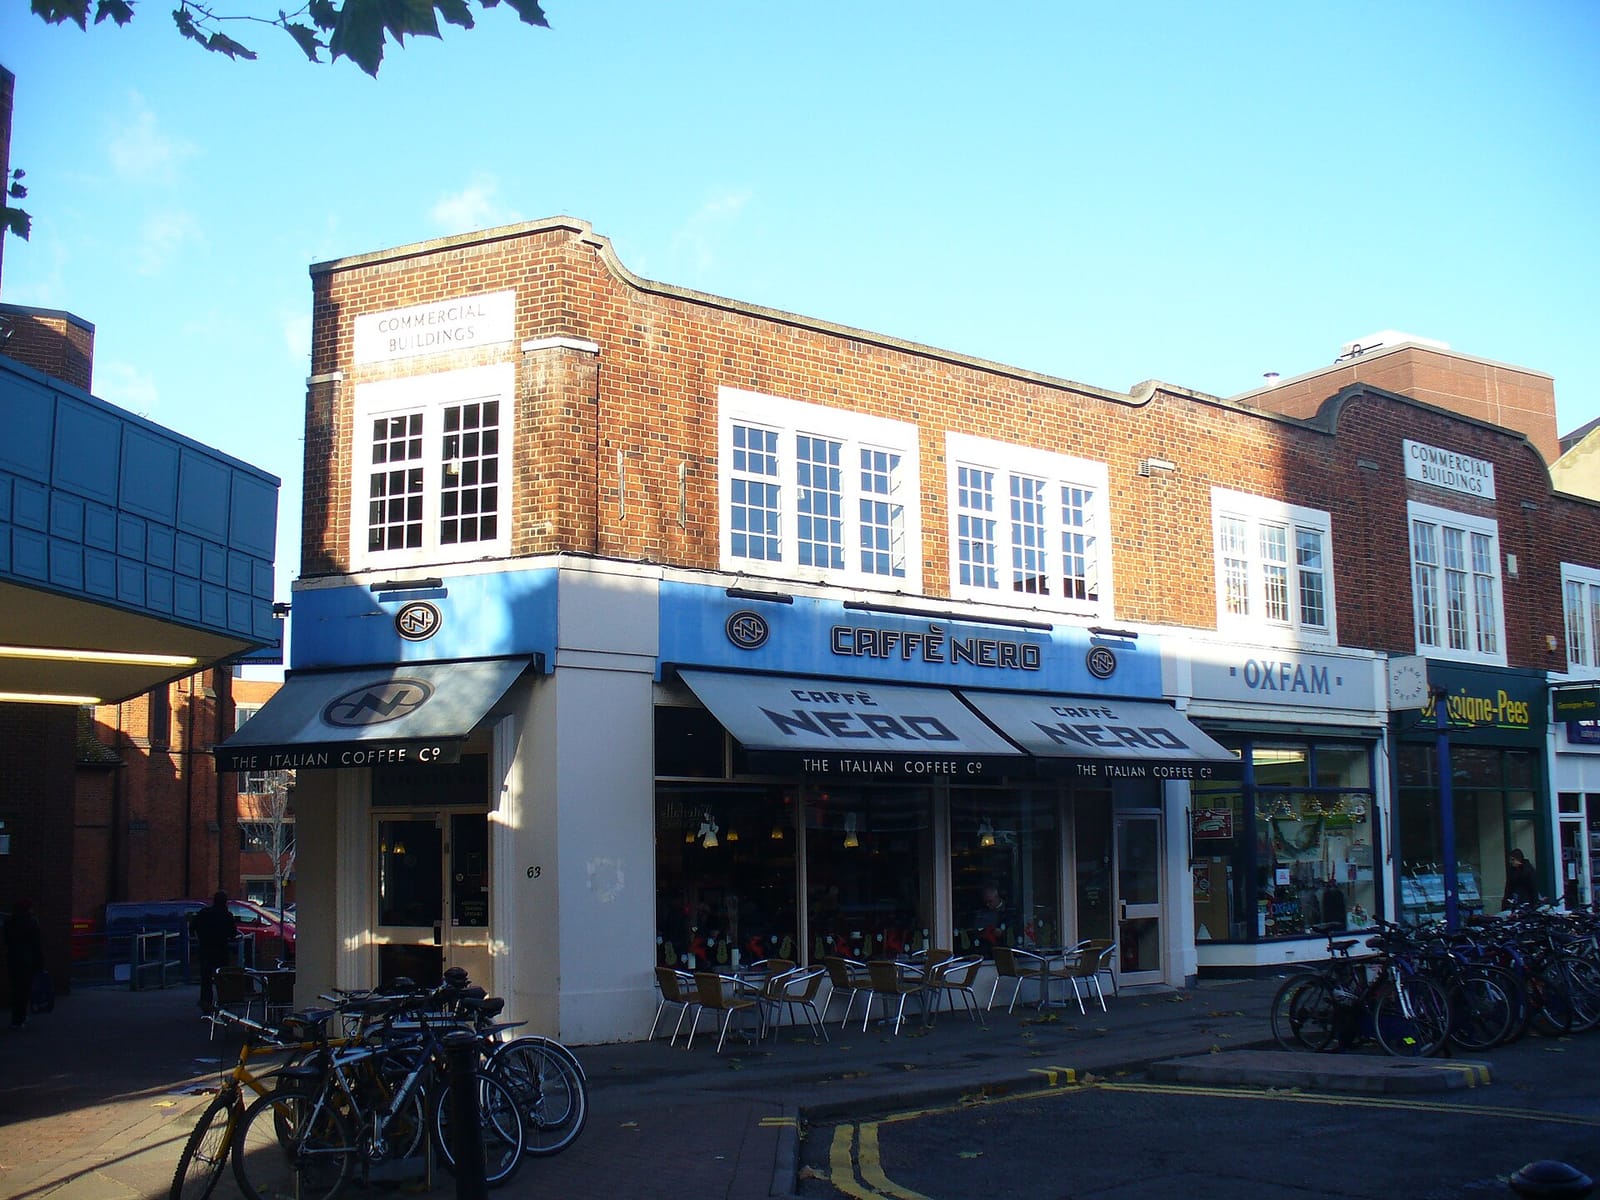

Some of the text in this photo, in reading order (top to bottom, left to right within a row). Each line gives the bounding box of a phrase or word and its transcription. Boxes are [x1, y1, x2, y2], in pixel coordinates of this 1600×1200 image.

[378, 304, 487, 333] COMMERCIAL
[389, 326, 475, 352] BUILDINGS
[1411, 444, 1489, 478] COMMERCIAL
[1422, 464, 1482, 492] BUILDINGS
[831, 623, 1041, 670] CAFFÈ NERO
[1243, 658, 1330, 695] OXFAM
[790, 689, 878, 707] CAFFÈ
[758, 705, 961, 742] NERO
[1031, 720, 1190, 750] NERO
[231, 756, 257, 769] THE
[269, 753, 328, 767] ITALIAN
[341, 749, 406, 765] COFFEE
[803, 758, 829, 772] THE
[840, 759, 893, 773] ITALIAN
[904, 761, 957, 774] COFFEE
[1076, 764, 1097, 776] THE
[1104, 765, 1146, 777] ITALIAN
[1153, 766, 1193, 778] COFFEE
[526, 866, 541, 879] 63
